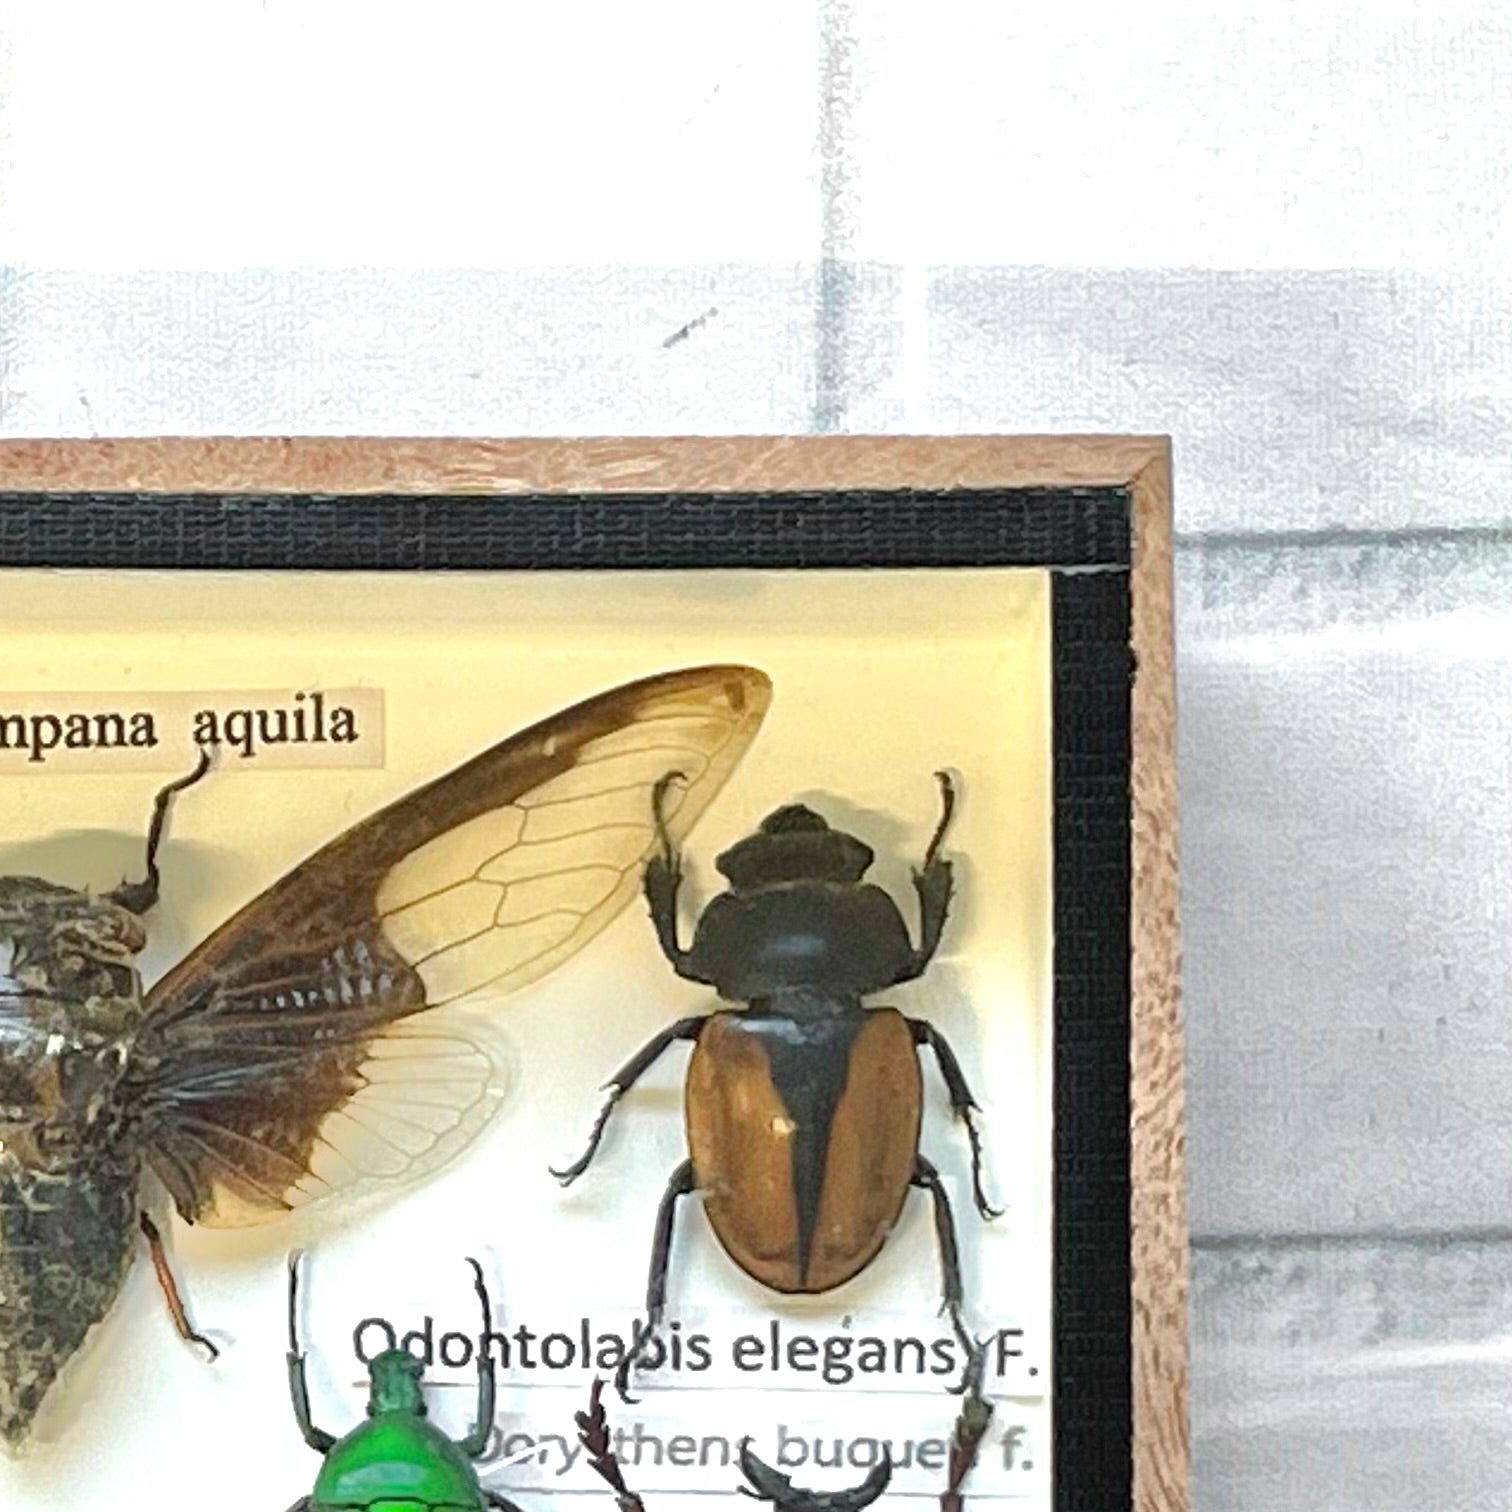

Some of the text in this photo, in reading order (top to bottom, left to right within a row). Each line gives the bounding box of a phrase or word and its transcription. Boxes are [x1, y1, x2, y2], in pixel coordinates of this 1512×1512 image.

[193, 693, 359, 757] aquila
[353, 1315, 1039, 1385] Odontolabis elegans F.
